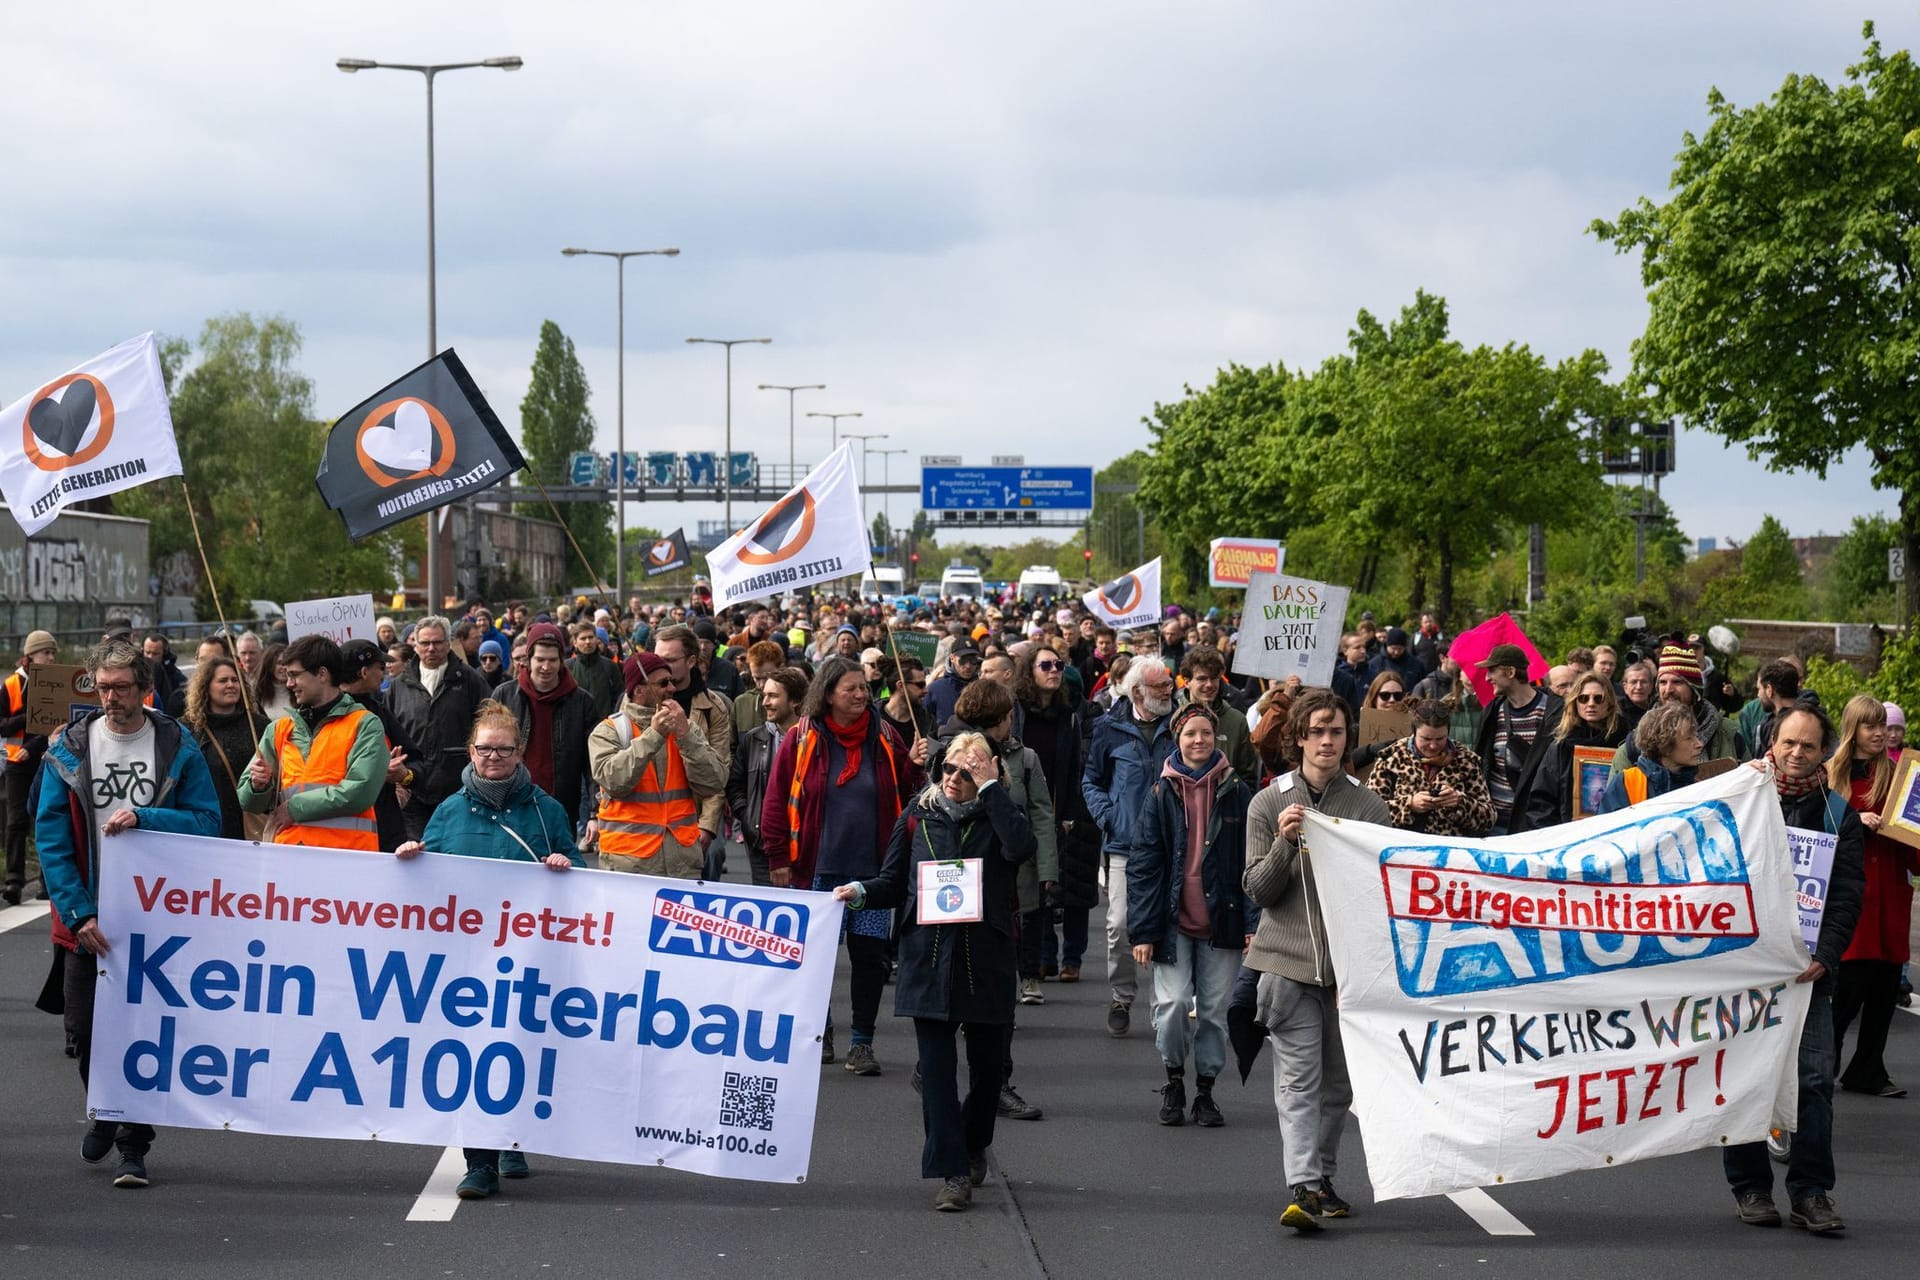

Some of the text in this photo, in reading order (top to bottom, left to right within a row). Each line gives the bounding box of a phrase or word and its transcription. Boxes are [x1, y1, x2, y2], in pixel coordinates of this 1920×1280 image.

[30, 458, 147, 519] LETZTE GENERATION
[332, 602, 367, 622] ÖPNV
[1273, 585, 1318, 605] BASS
[1264, 635, 1317, 650] BETON
[1281, 623, 1314, 635] STATT
[31, 668, 64, 694] Tempo
[133, 876, 614, 947] Verkehrswende jetzt!
[1408, 870, 1736, 932] Bürgerinitiative
[660, 901, 801, 960] Bürgerinitiative
[126, 933, 794, 1064] Kein Weiterbau
[123, 1016, 557, 1120] der A100!
[635, 1125, 778, 1157] www.bi-a100.de
